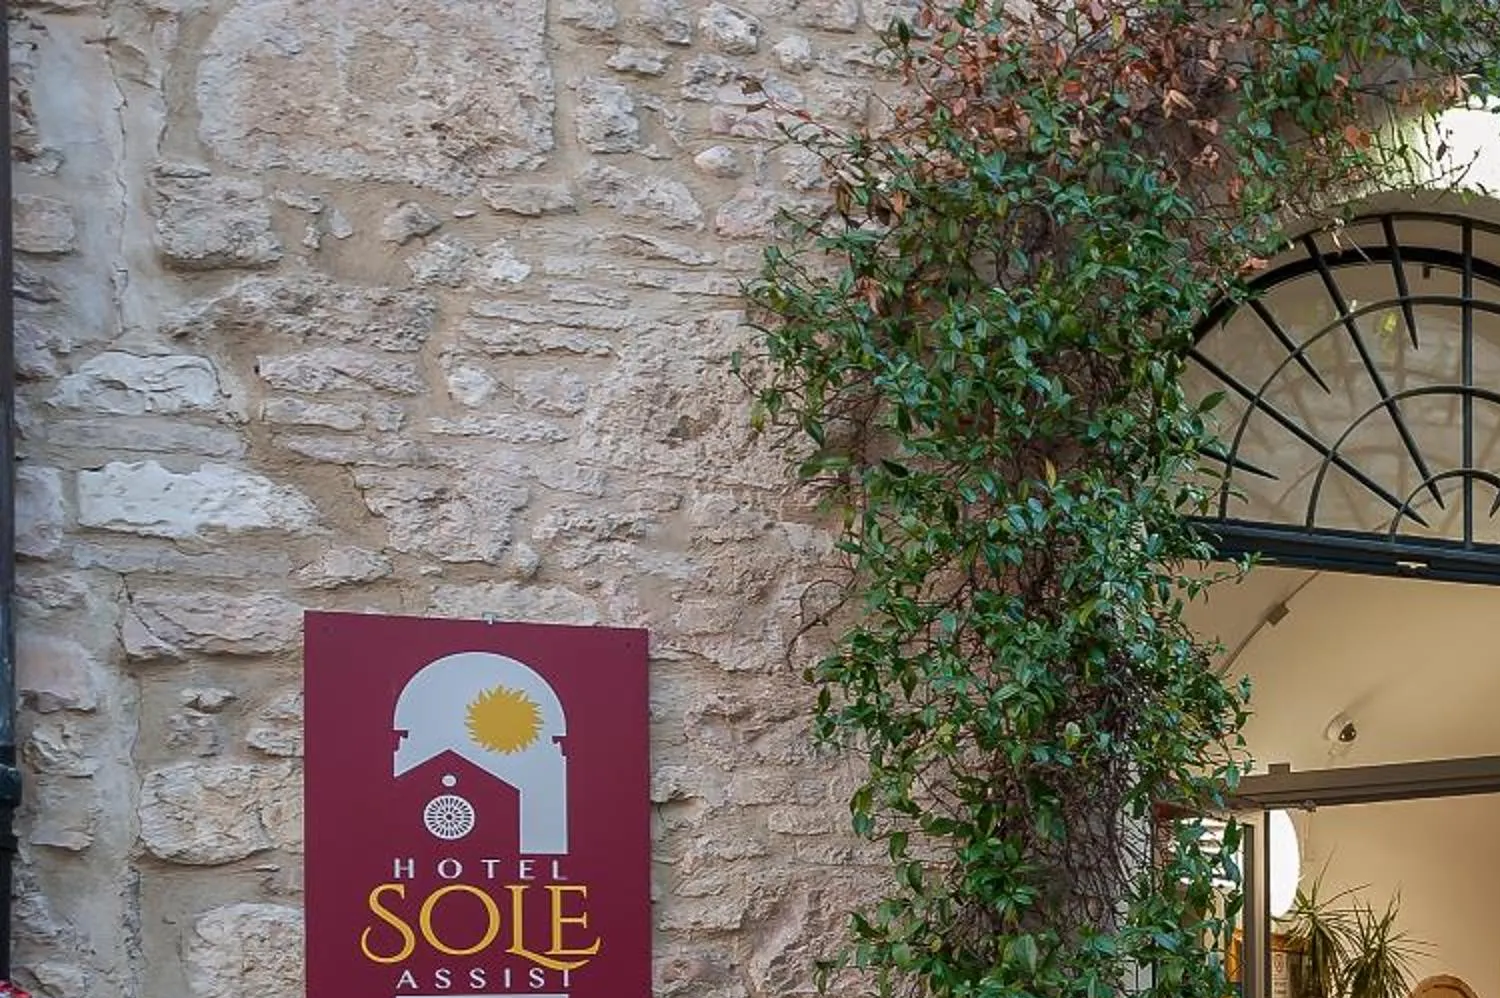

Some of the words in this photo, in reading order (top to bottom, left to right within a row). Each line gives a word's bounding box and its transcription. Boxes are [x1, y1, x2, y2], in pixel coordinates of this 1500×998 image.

[394, 858, 569, 880] HOTEL
[361, 883, 601, 971] SOLE
[396, 968, 569, 990] ASSISI
